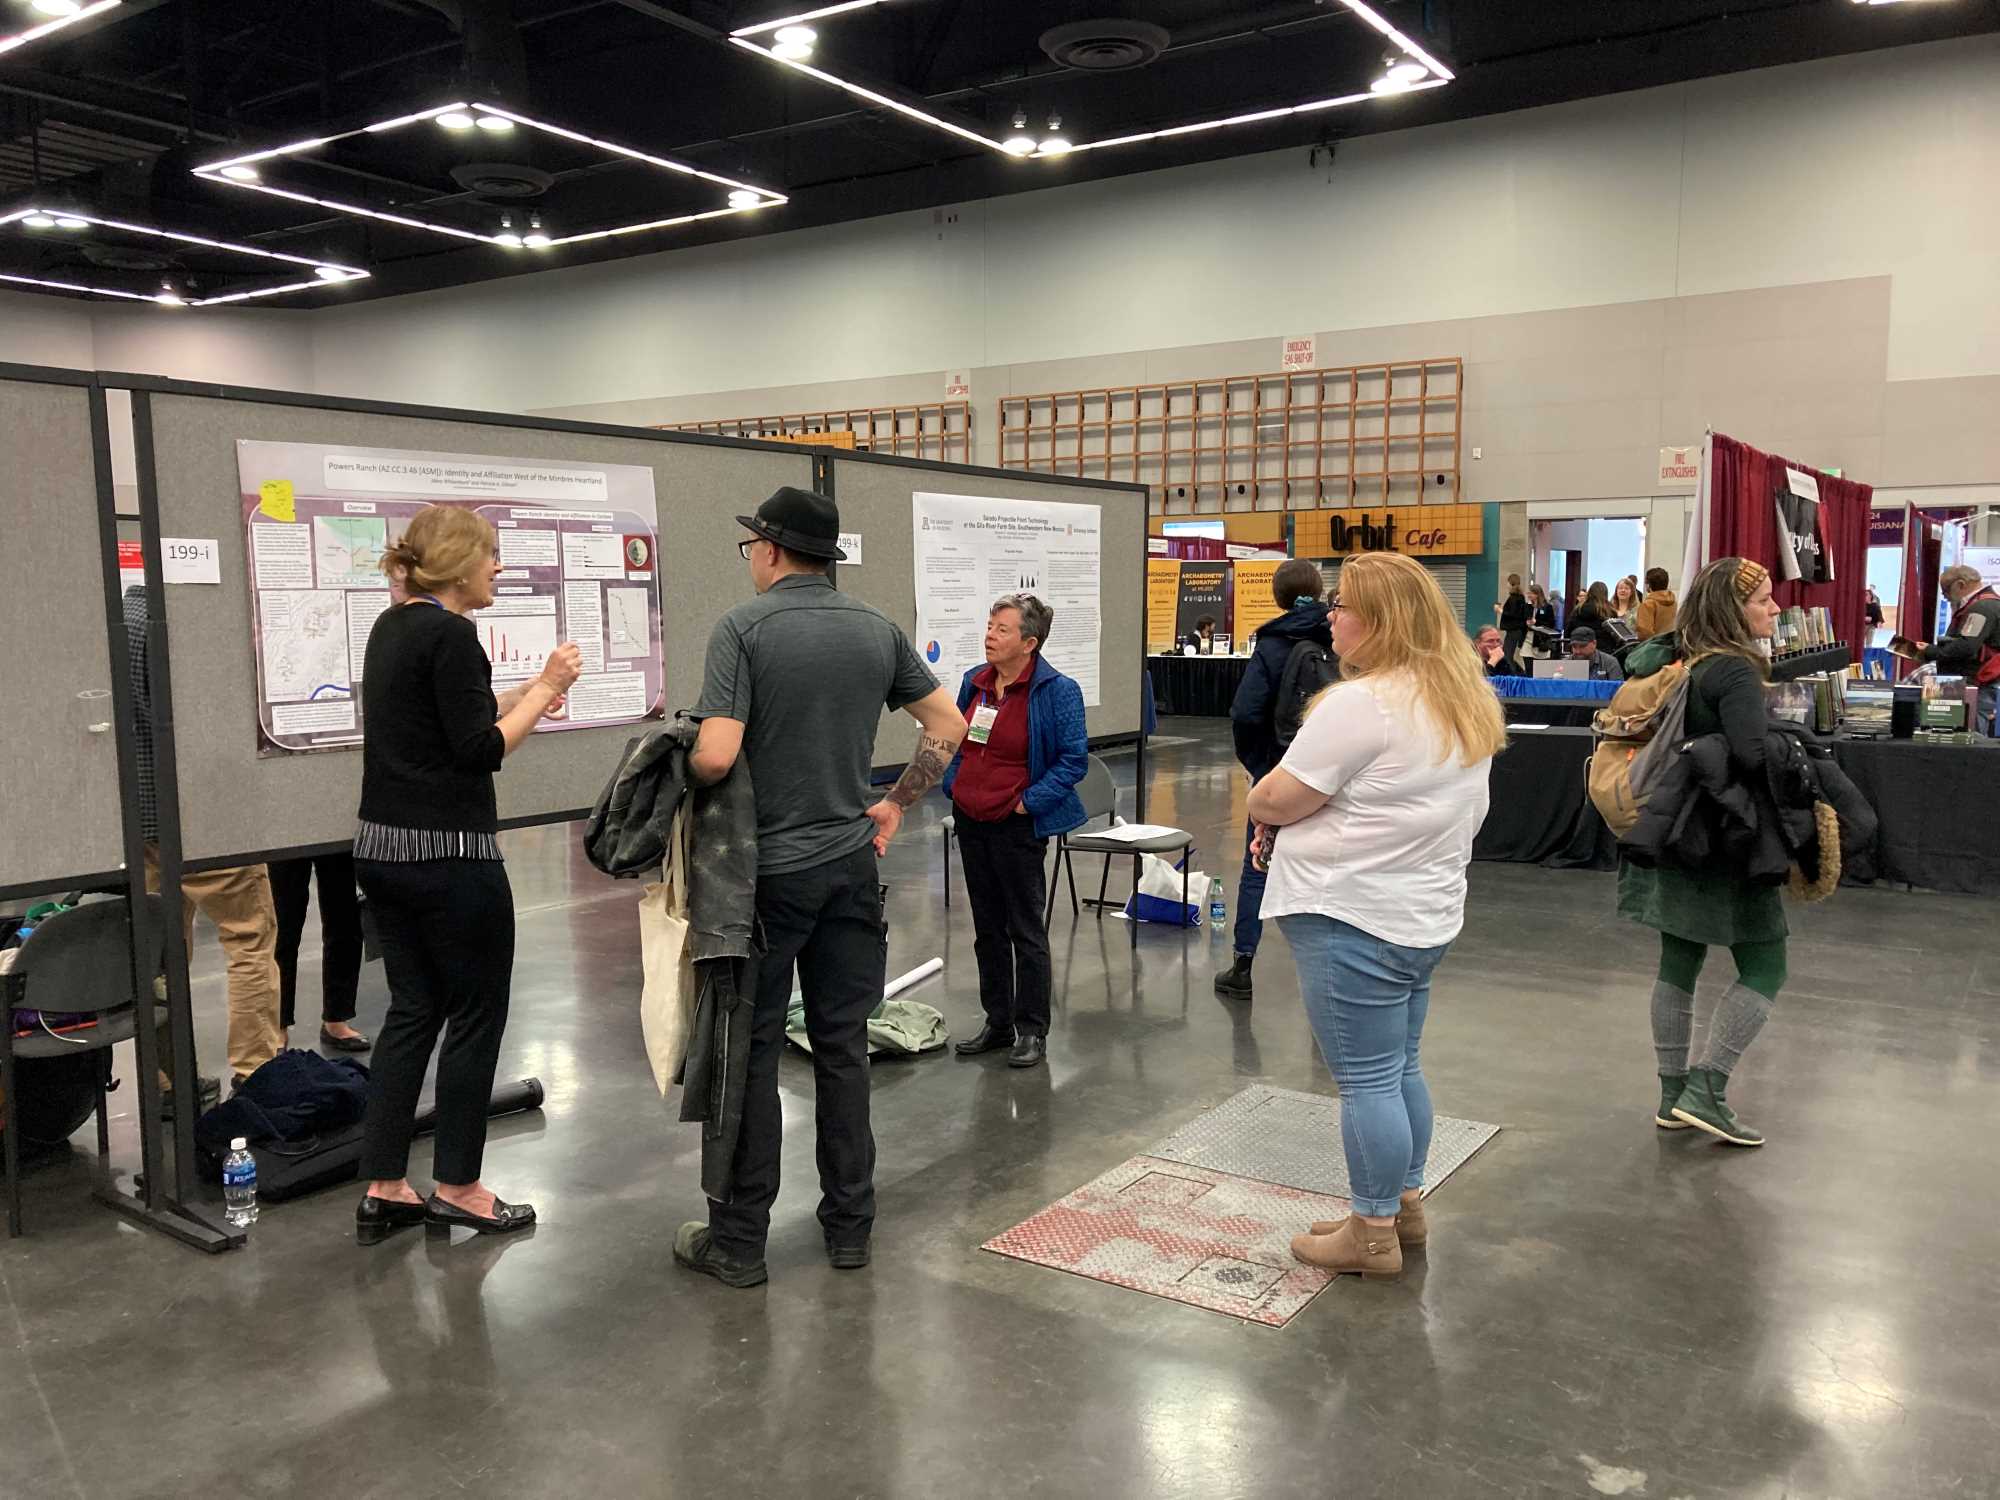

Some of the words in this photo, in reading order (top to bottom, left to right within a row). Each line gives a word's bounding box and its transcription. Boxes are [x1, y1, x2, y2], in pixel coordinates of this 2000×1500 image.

[328, 462, 354, 471] Powers
[355, 463, 377, 472] Ranch
[470, 471, 482, 479] and
[483, 471, 513, 481] Affiliation
[514, 473, 529, 481] West
[538, 474, 547, 482] the
[1661, 466, 1697, 479] EXTINGUISHER
[1330, 513, 1399, 551] Orbit
[1405, 528, 1448, 549] Cafe
[168, 545, 209, 560] 199-i
